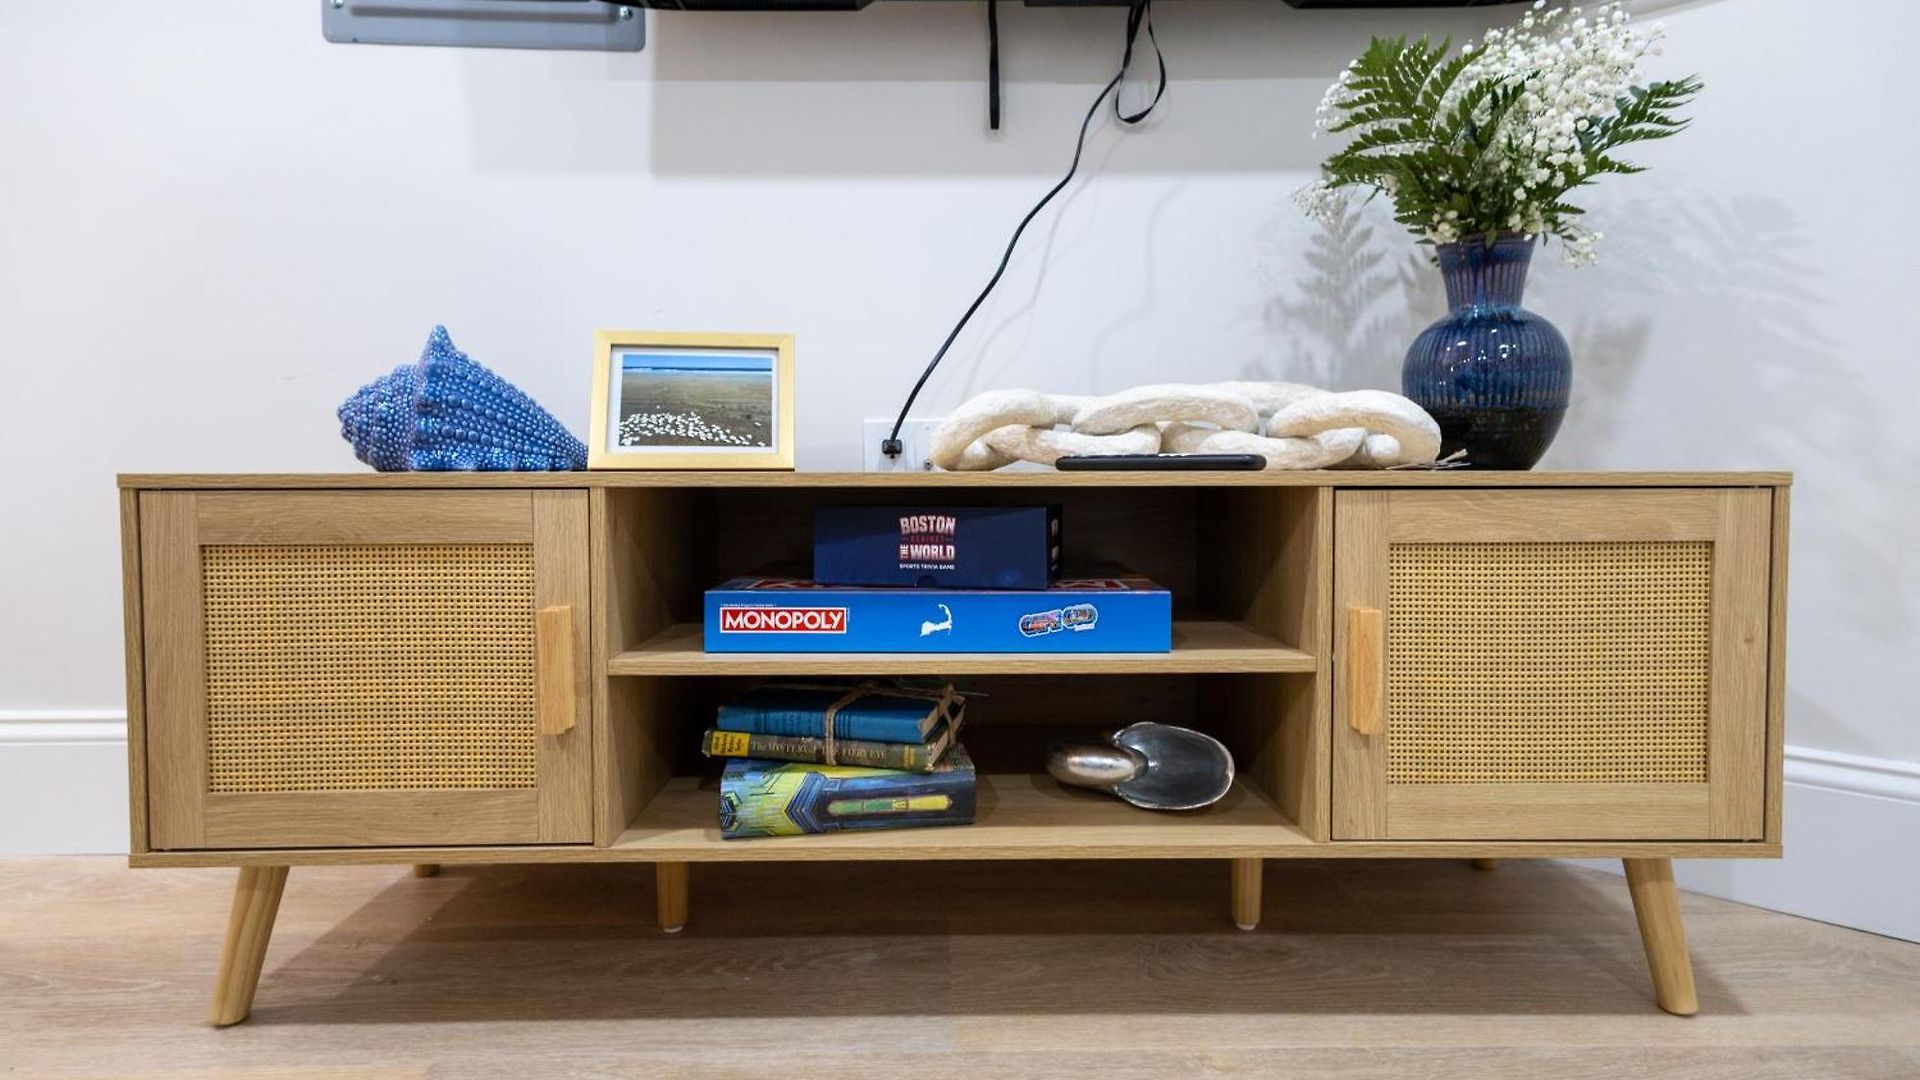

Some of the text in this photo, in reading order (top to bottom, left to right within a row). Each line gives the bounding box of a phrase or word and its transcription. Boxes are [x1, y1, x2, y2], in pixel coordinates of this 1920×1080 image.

[900, 515, 955, 534] BOSTON
[900, 544, 955, 560] THE WORLD
[725, 611, 843, 629] MONOPOLY
